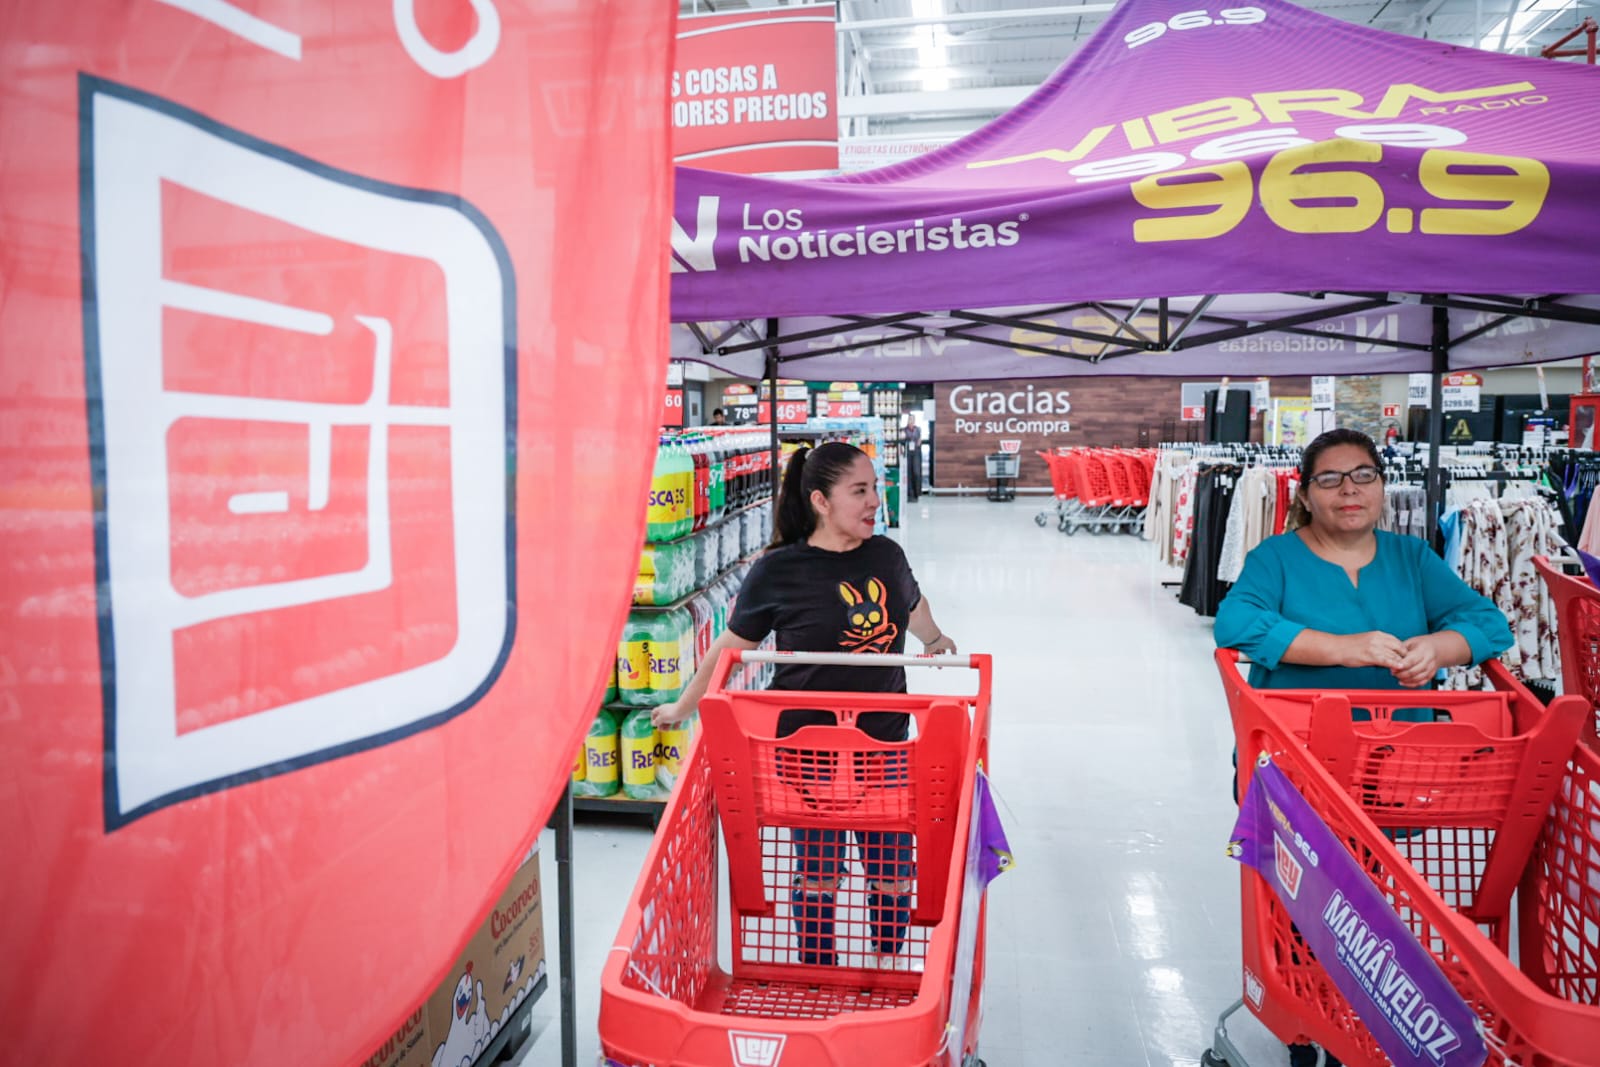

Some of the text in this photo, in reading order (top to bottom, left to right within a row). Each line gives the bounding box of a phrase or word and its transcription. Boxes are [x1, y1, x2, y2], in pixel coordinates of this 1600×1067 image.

[1124, 6, 1267, 49] 96.9
[685, 66, 759, 95] COSAS
[762, 64, 777, 90] A
[733, 91, 828, 124] PRECIOS
[1419, 95, 1549, 116] RADIO
[1130, 137, 1551, 243] 96.9
[949, 385, 1071, 415] Gracias
[955, 417, 1071, 437] Por su Compra
[648, 490, 674, 507] SCA
[1323, 893, 1456, 1058] MAMÁ VELOZ
